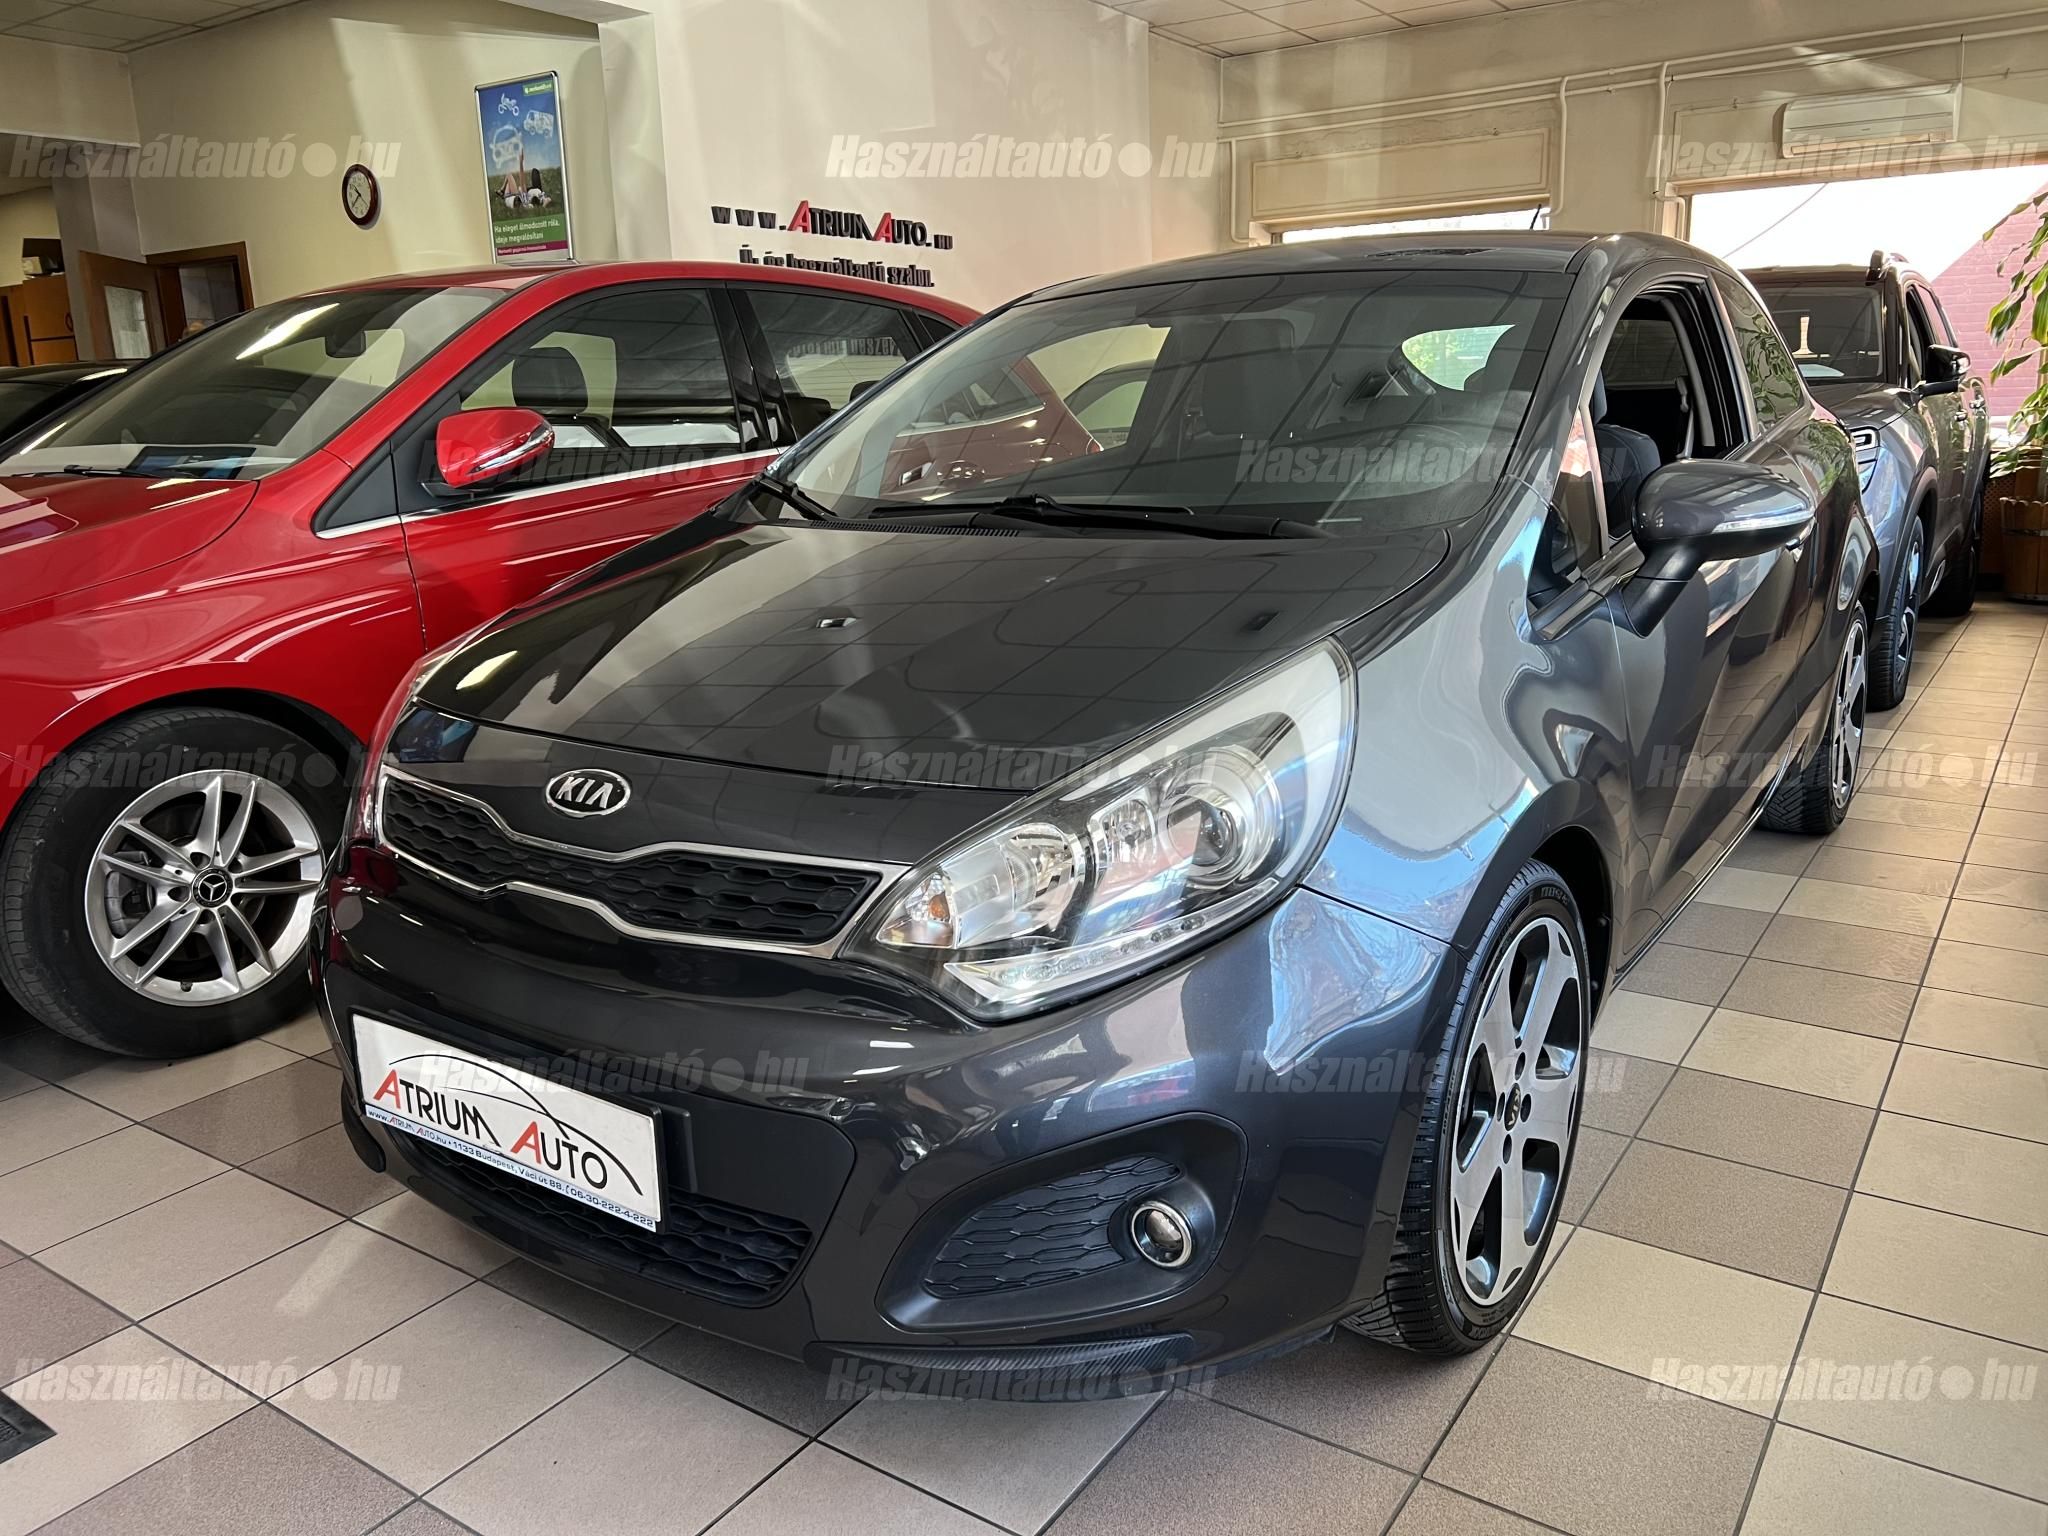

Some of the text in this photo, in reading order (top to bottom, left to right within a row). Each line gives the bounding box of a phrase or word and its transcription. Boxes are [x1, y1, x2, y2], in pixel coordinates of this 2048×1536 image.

[555, 776, 613, 809] KIA
[373, 1069, 608, 1190] ATRIUM AUTO
[453, 1141, 475, 1155] 1133
[476, 1150, 517, 1173] Budapest,
